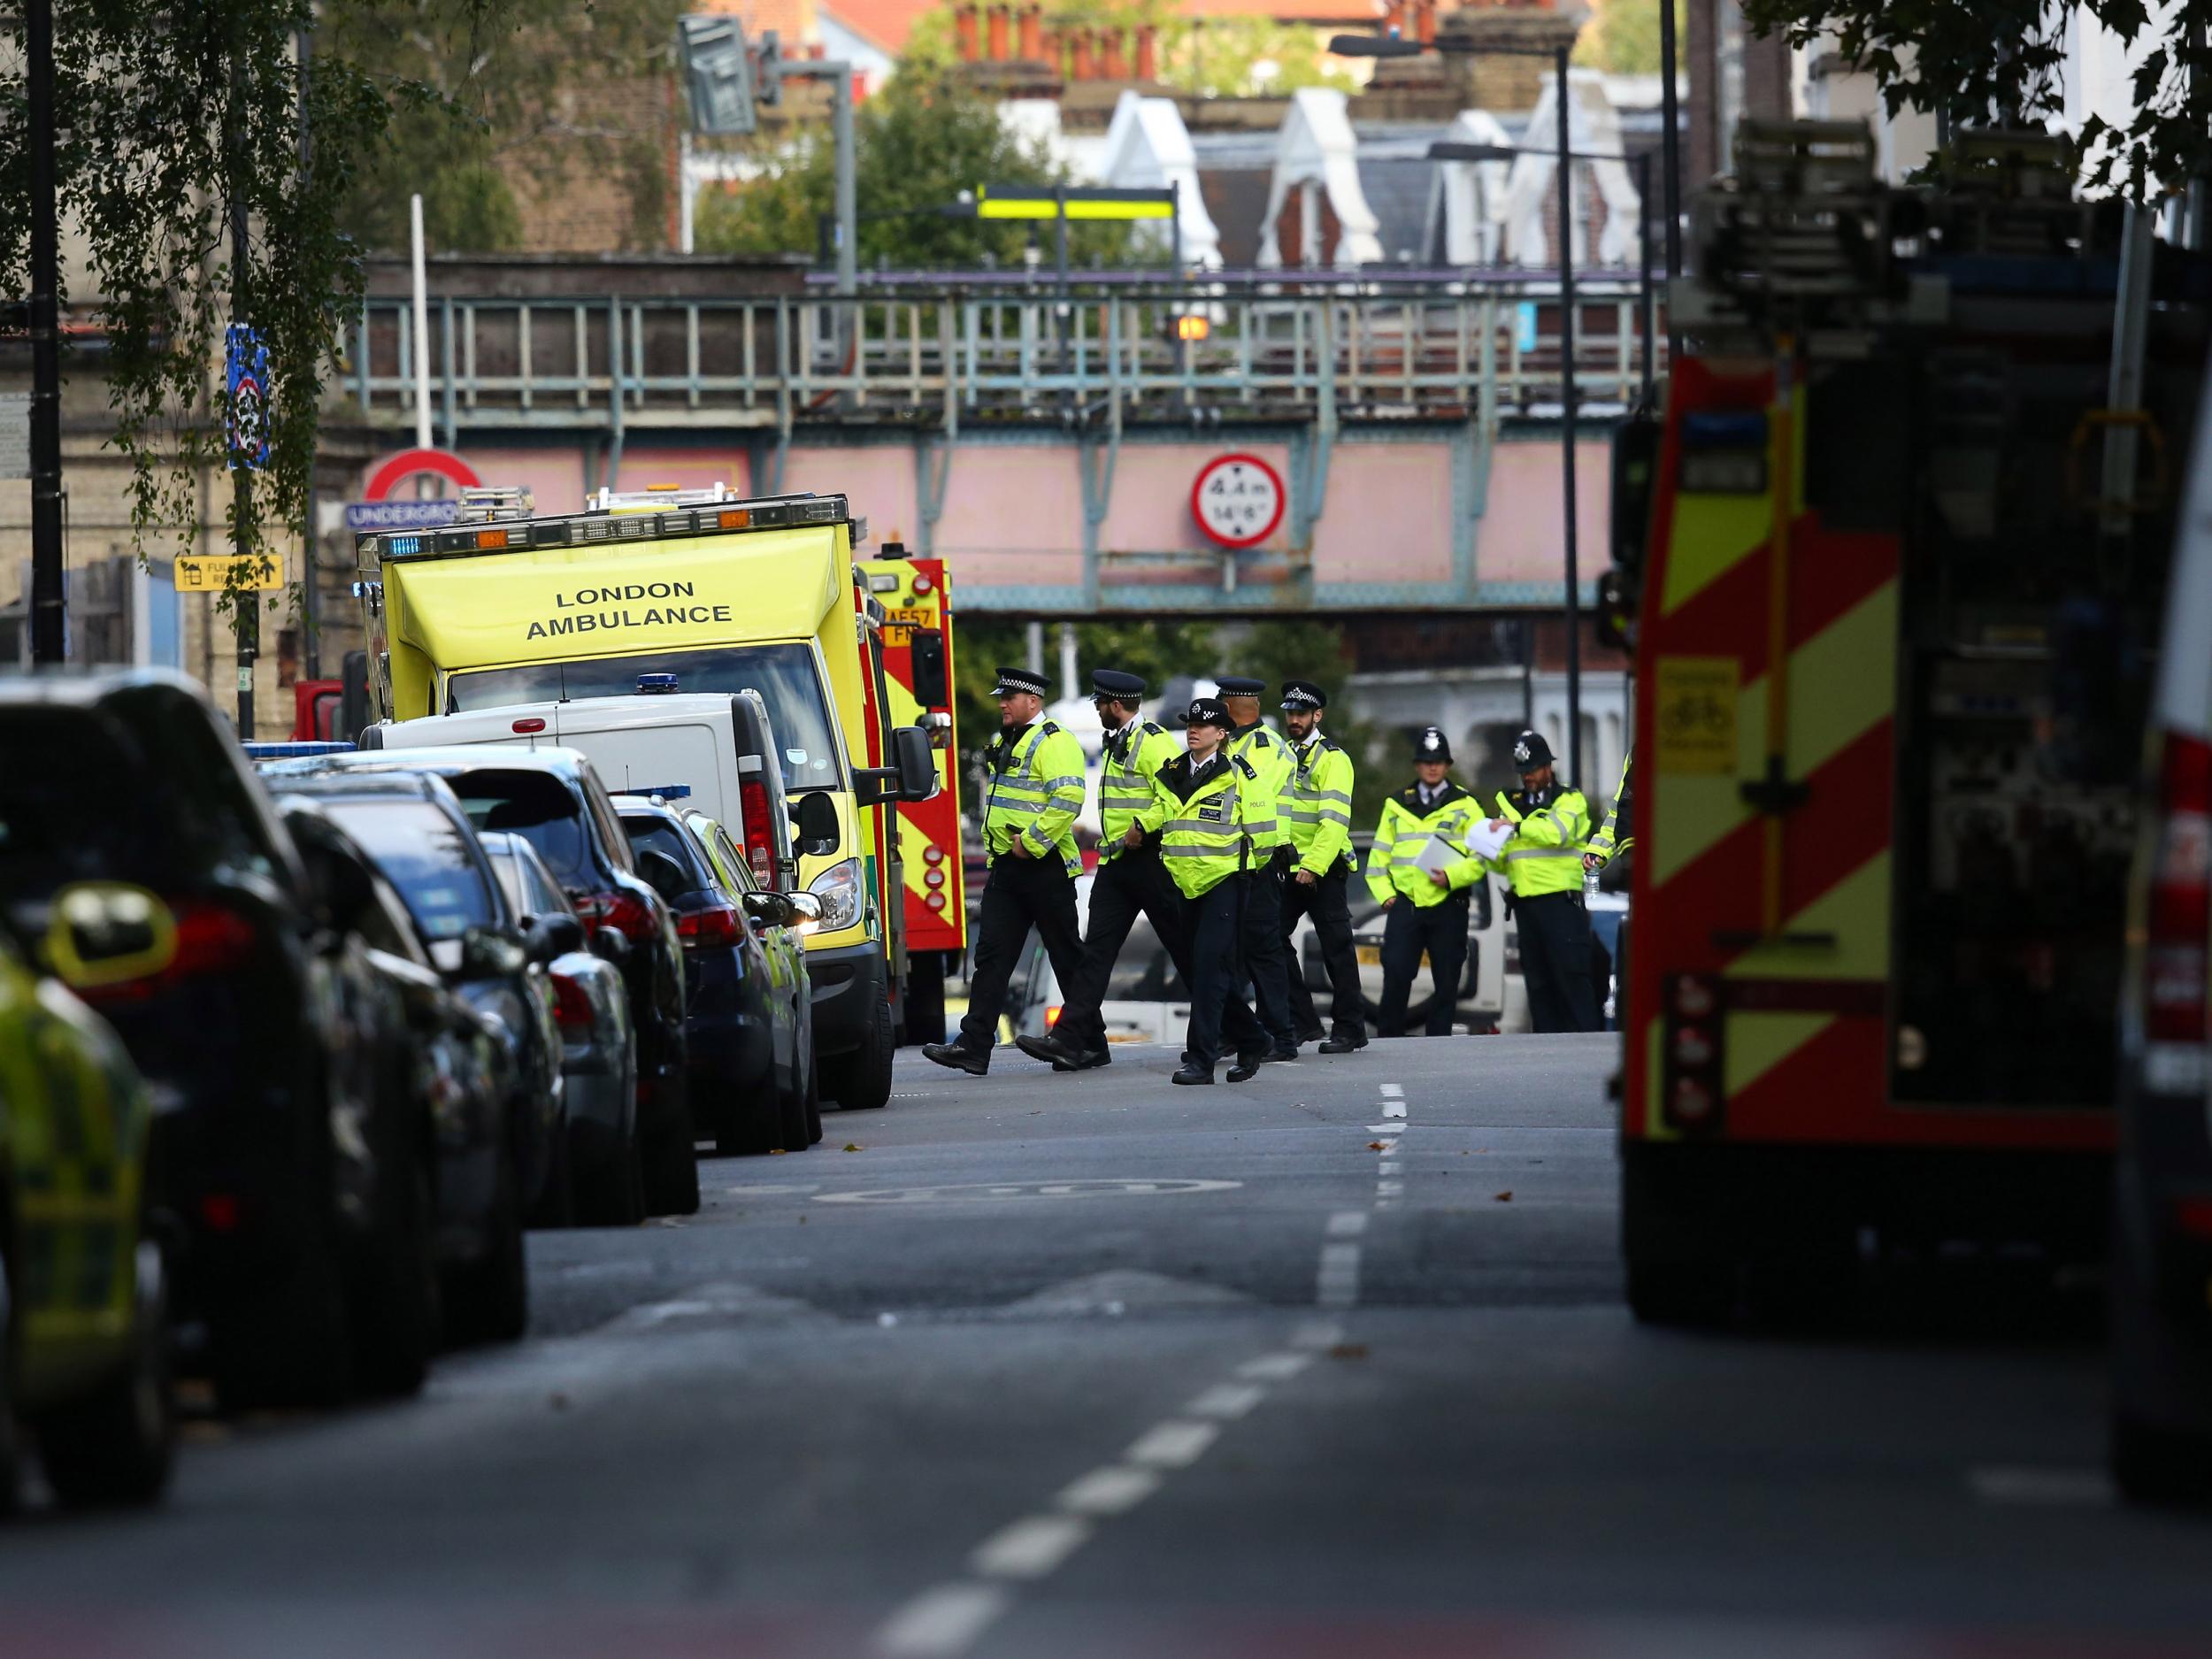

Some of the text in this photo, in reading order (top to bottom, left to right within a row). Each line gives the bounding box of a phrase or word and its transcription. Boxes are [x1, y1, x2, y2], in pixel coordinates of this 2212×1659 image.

[351, 503, 457, 525] UNDERGRO
[557, 581, 694, 608] LONDON
[526, 605, 733, 641] AMBULANCE
[889, 610, 931, 625] AE57
[895, 626, 915, 641] FN
